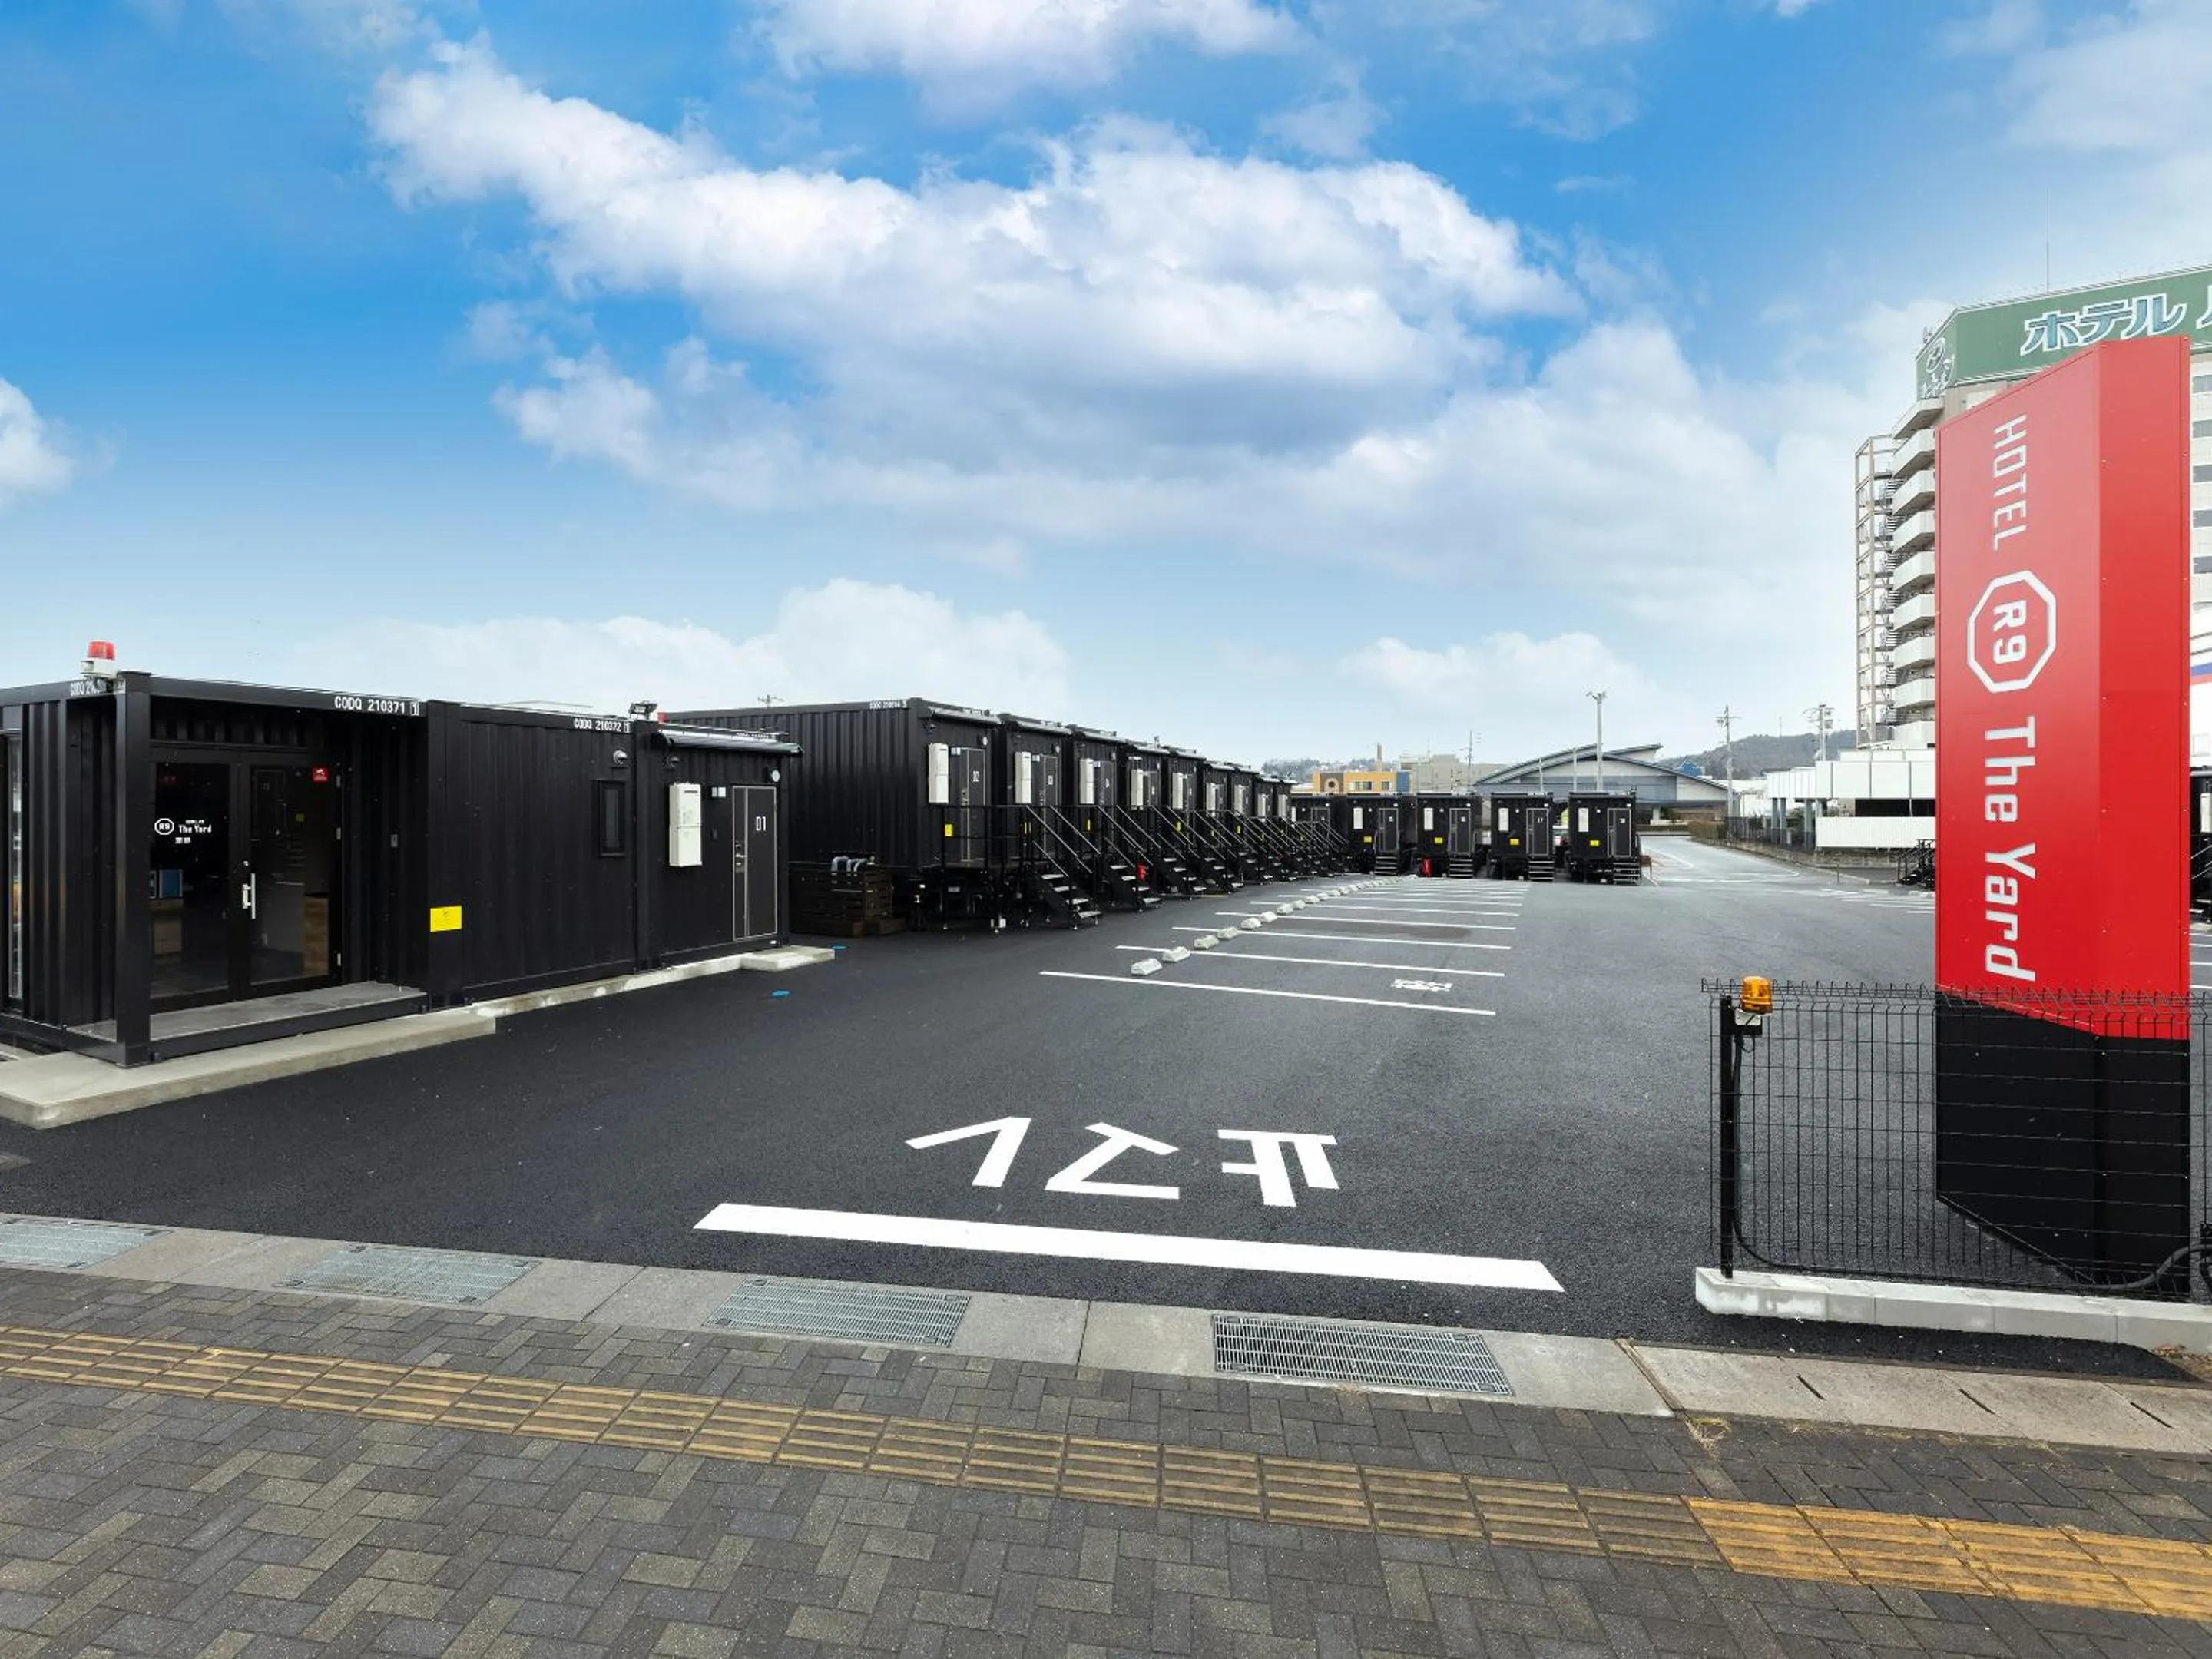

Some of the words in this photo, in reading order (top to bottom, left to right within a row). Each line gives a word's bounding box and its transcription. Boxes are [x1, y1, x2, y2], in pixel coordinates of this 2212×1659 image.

[2020, 293, 2187, 356] ホテル
[1993, 414, 2027, 551] HOTEL
[1993, 600, 2027, 664] R9
[367, 699, 406, 715] 210371
[1985, 715, 2036, 822] The
[756, 816, 767, 831] 01
[1985, 843, 2036, 982] Yard
[906, 1116, 1339, 1207] 止マレ
